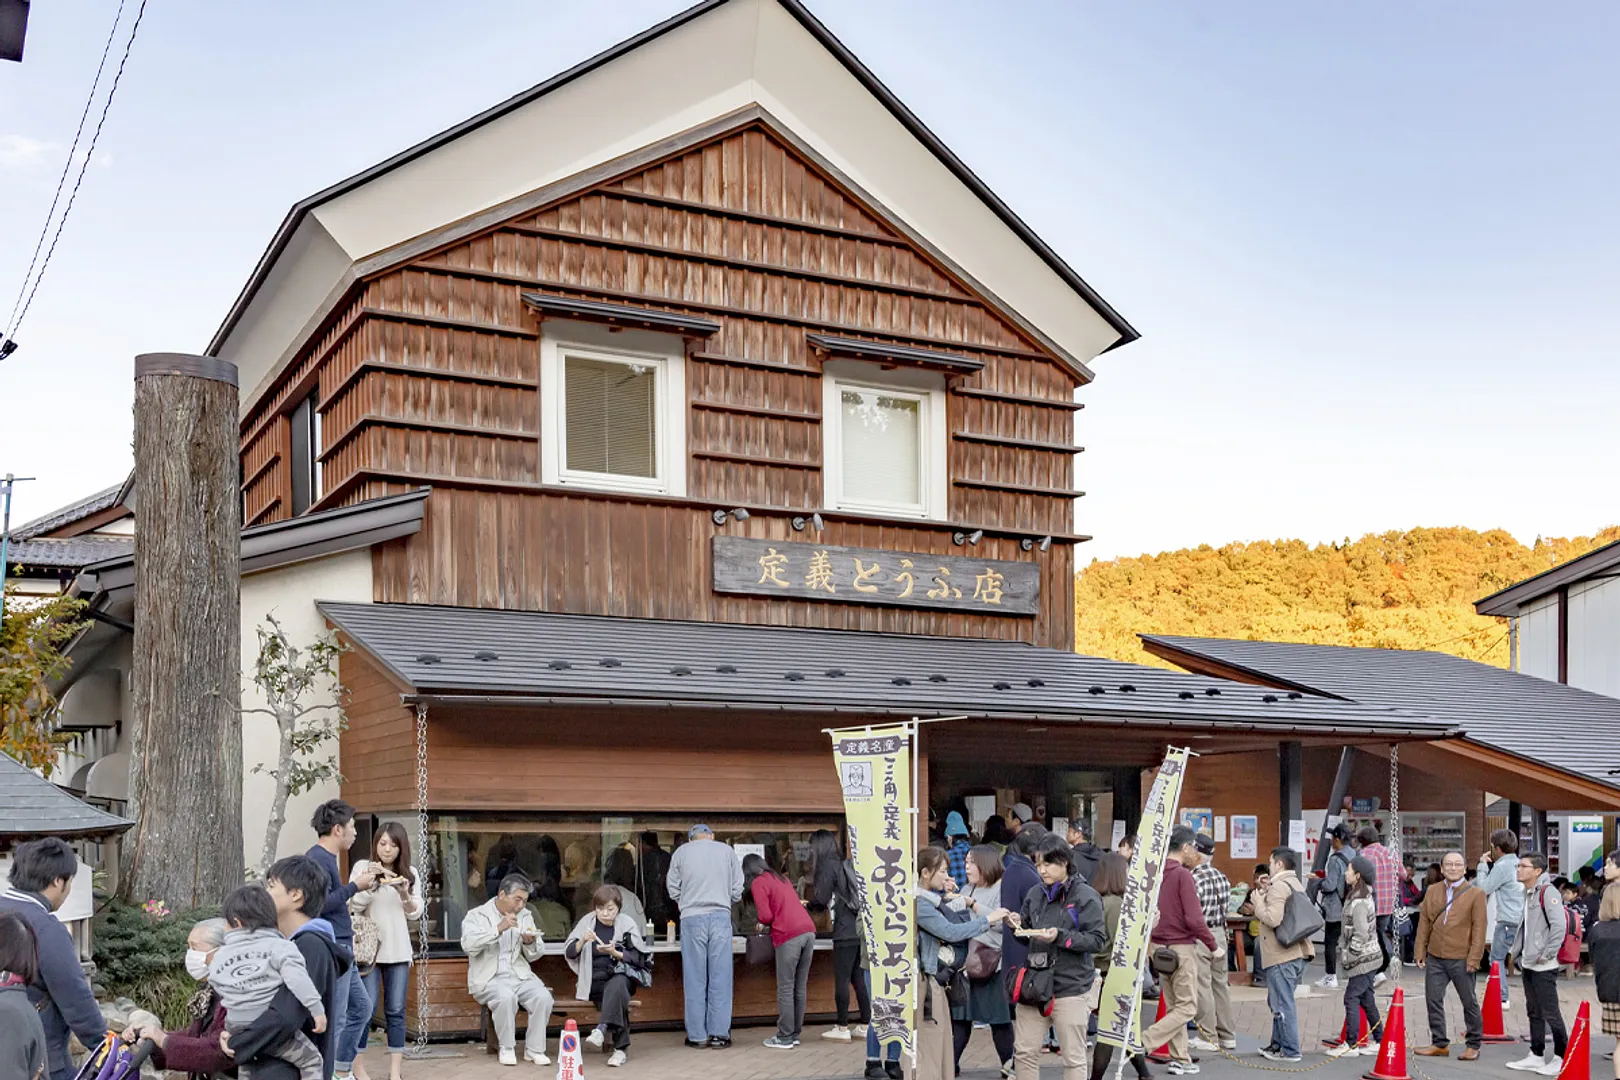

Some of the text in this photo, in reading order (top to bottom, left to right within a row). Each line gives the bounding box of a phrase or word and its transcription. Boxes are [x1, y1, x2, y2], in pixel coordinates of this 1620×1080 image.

[758, 547, 1004, 605] 定義とうふ店
[846, 739, 896, 754] 定義名産
[870, 845, 911, 997] あぶらあげ
